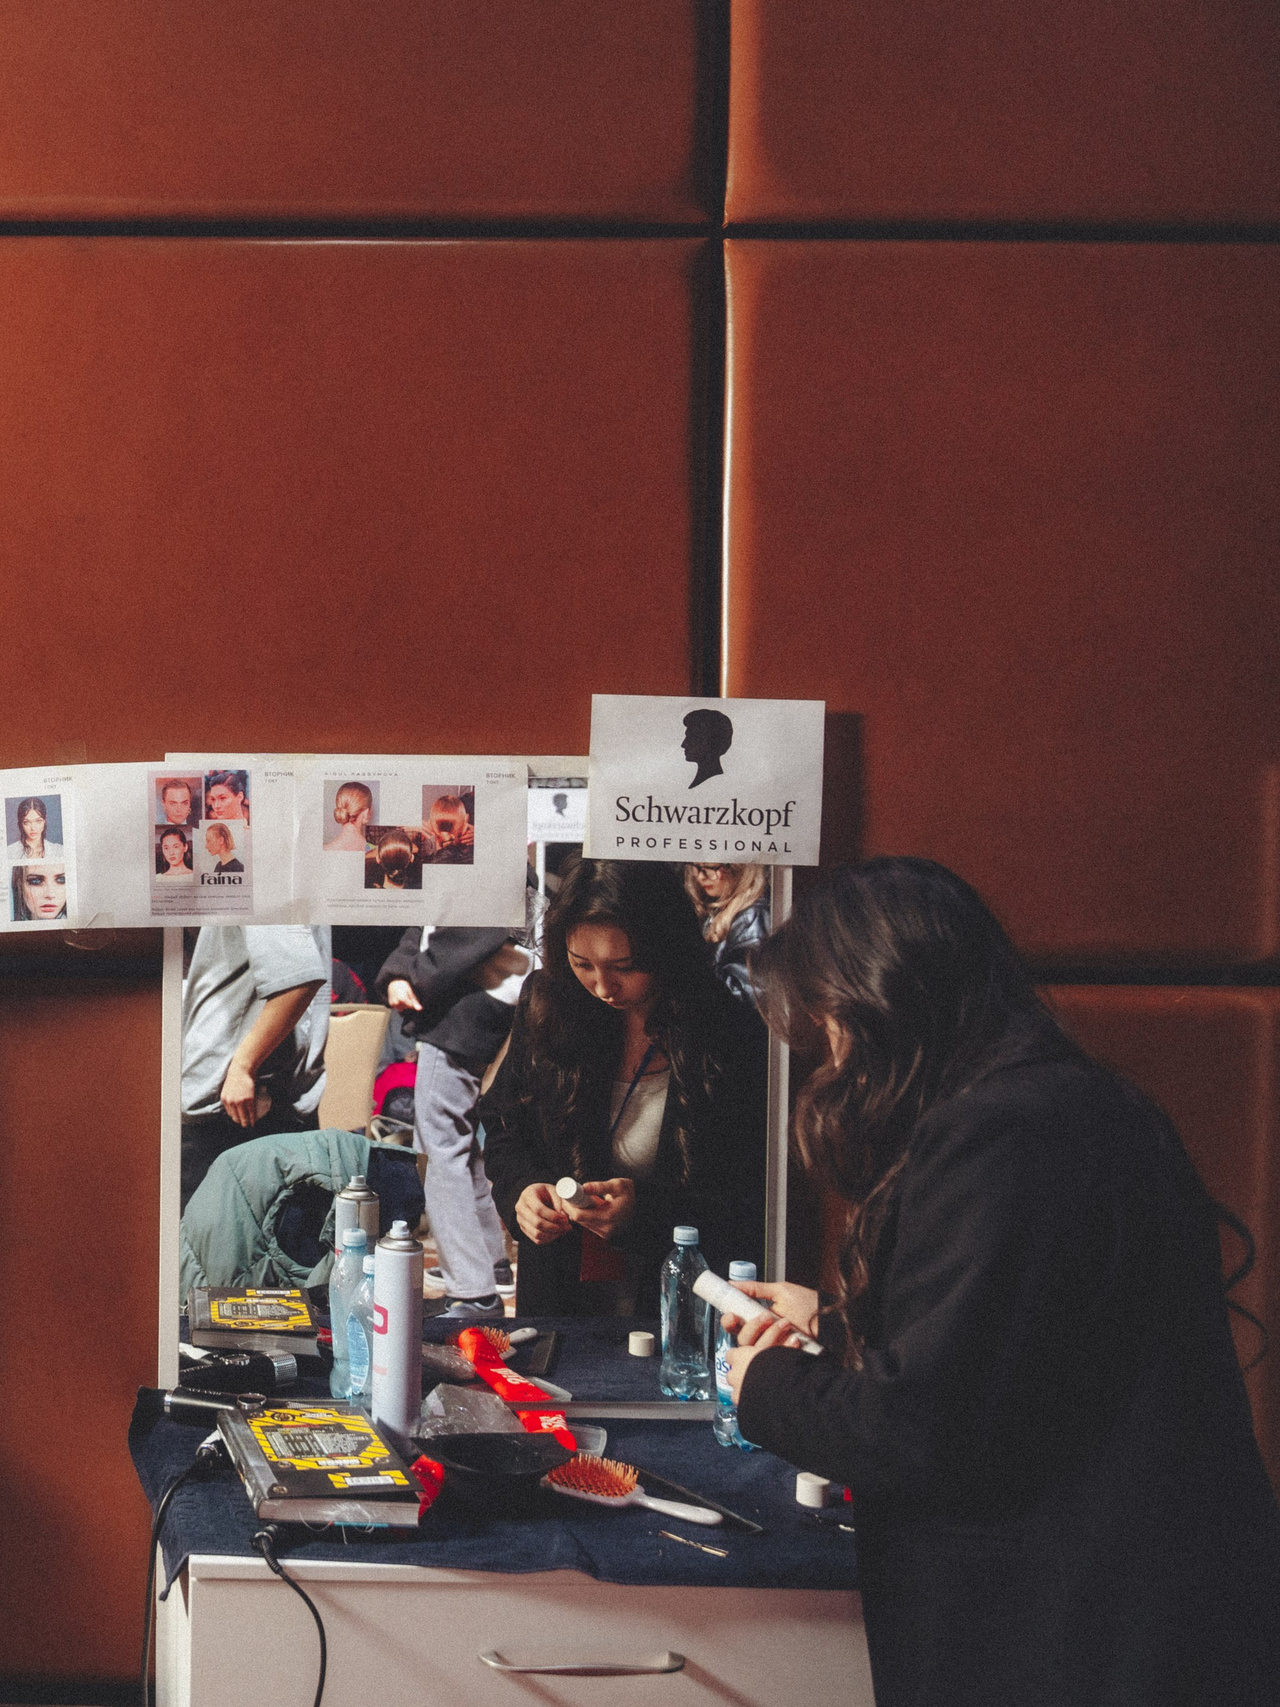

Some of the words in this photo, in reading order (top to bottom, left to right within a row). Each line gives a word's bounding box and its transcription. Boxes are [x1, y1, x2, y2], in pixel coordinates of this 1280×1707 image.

[615, 795, 797, 836] Schwarzkopf
[616, 836, 792, 853] PROFESSIONAL
[200, 872, 243, 885] faina
